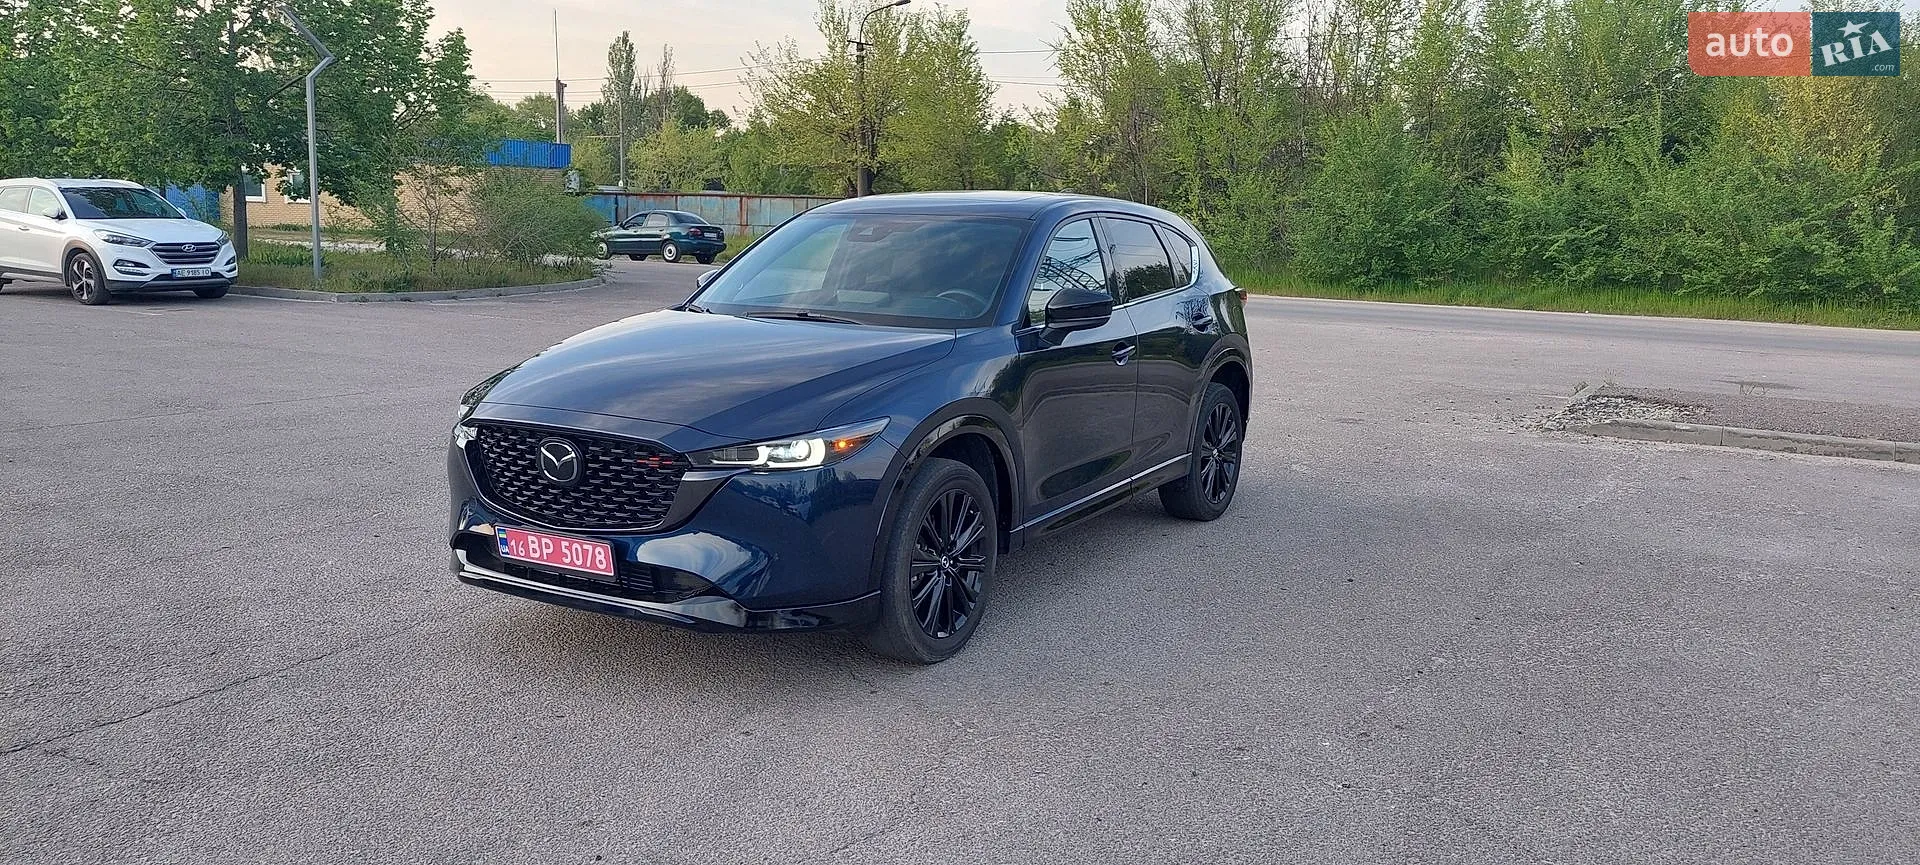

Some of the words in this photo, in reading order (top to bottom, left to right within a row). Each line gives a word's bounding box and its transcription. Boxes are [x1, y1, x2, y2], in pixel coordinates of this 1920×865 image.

[500, 545, 509, 553] UA
[510, 538, 525, 557] 16
[527, 535, 554, 560] BP
[561, 541, 607, 570] 5078
